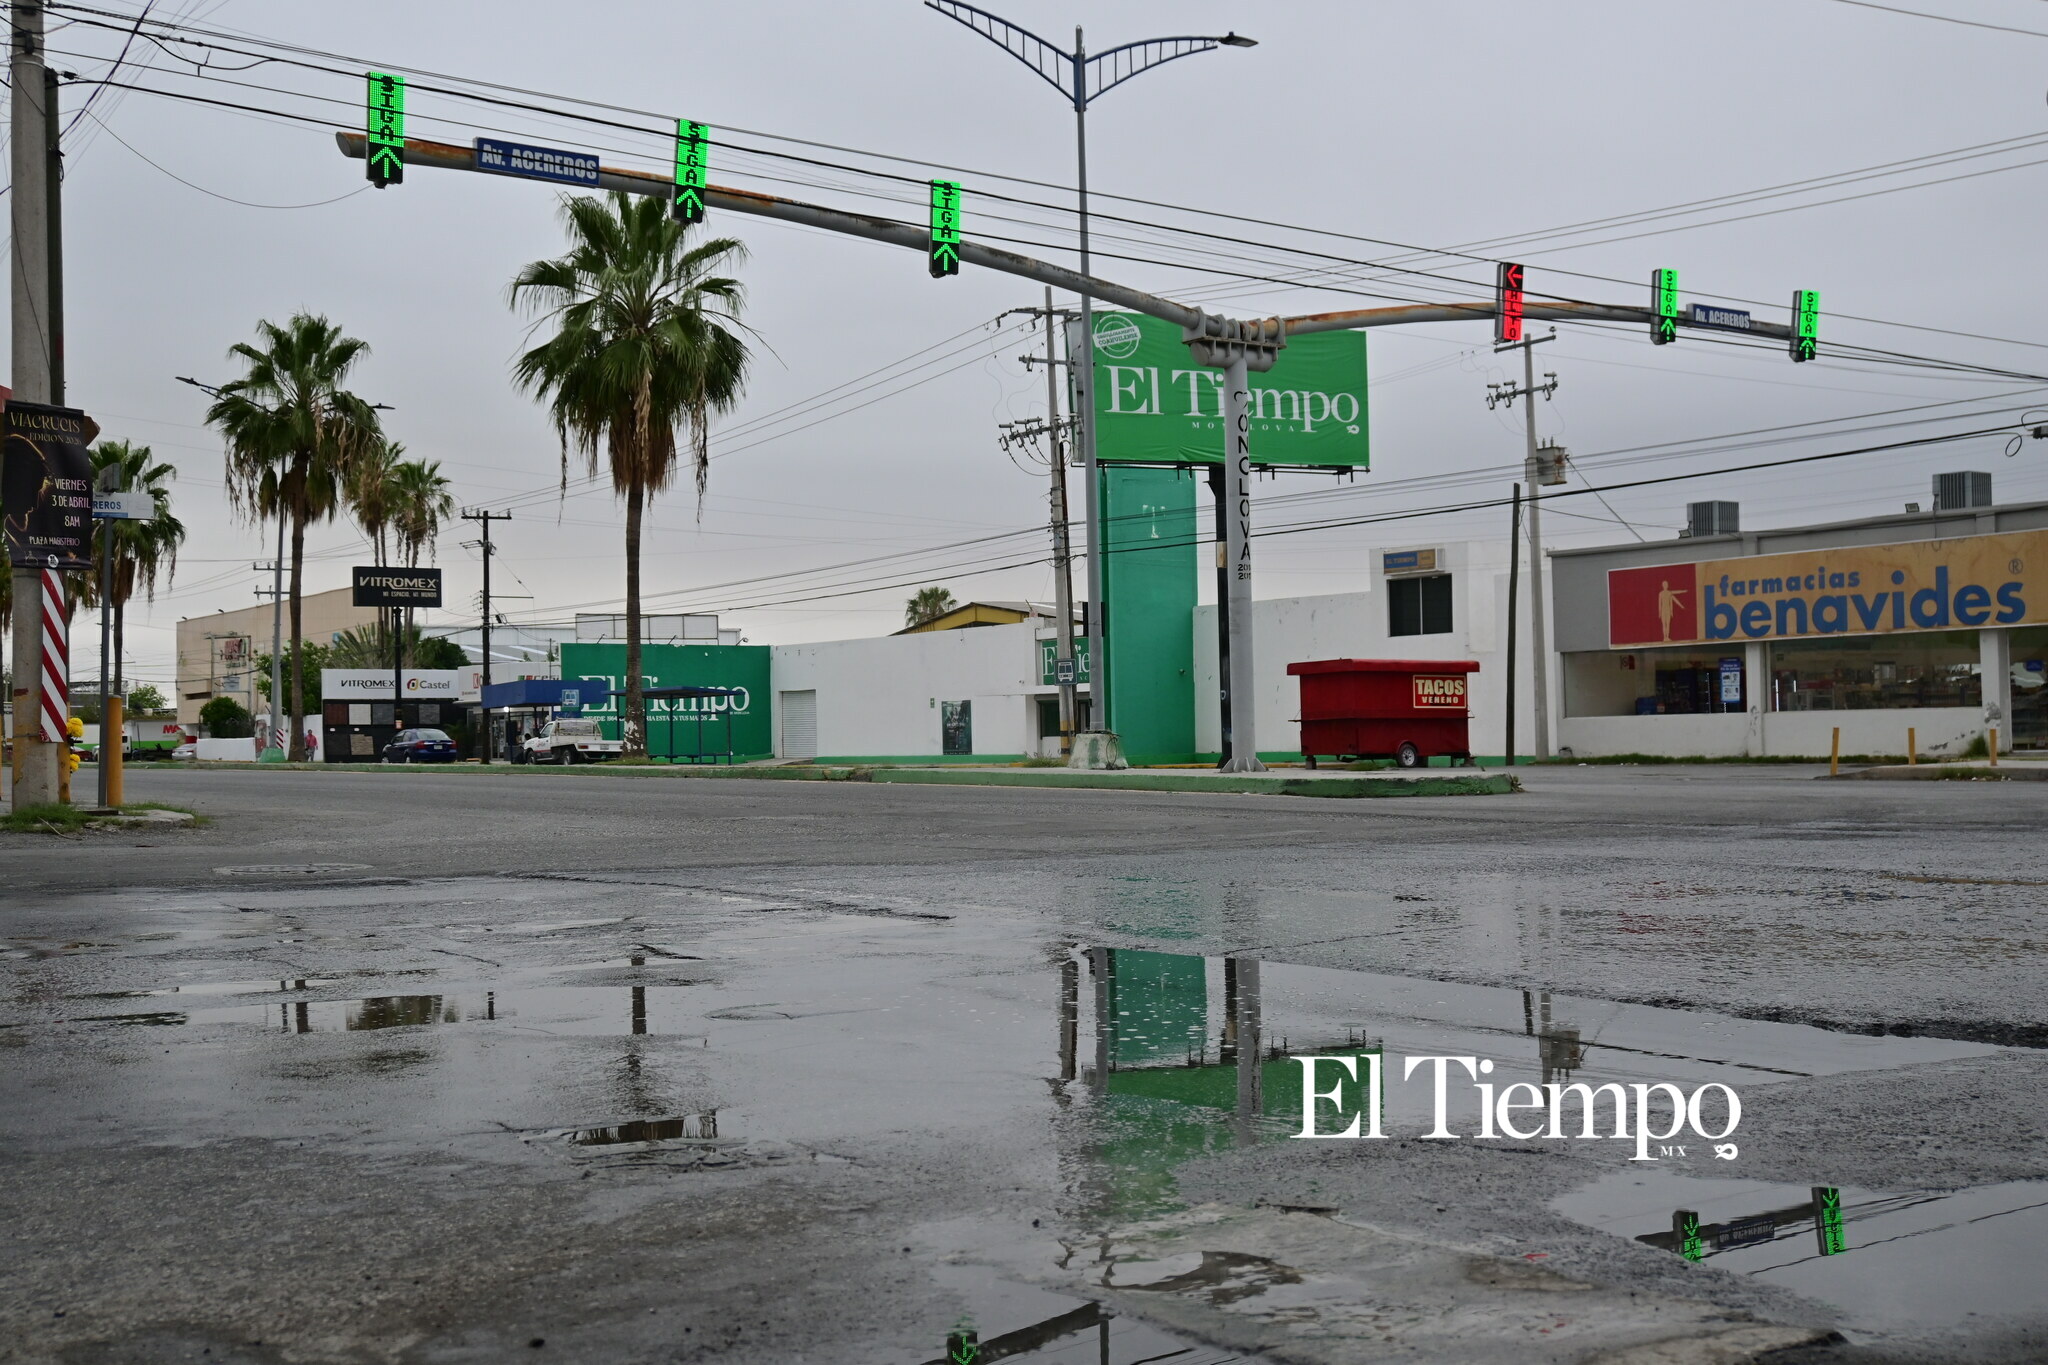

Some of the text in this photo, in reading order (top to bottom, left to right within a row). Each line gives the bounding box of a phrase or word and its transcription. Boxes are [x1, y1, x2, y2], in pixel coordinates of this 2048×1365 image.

[685, 120, 701, 185] SIGA
[481, 143, 598, 181] Av. ACEREROS
[1665, 270, 1674, 315] SIGA
[1708, 311, 1750, 329] ACEREROS
[1804, 291, 1814, 334] SIGA
[1102, 364, 1360, 433] El Timpo
[10, 411, 81, 434] VIACRUCIS
[1191, 421, 1296, 433] MOLOVA
[54, 478, 87, 491] VIERNES
[51, 494, 91, 508] 3 DE ABRIL
[64, 515, 80, 527] 8AM
[29, 535, 81, 547] PLAZA MAGISTERIO
[359, 576, 436, 591] VITROMEX
[1719, 566, 1861, 597] farmacias
[1704, 565, 2026, 640] benavides
[341, 679, 395, 689] VITROMEX
[419, 680, 450, 689] Castel
[1415, 679, 1465, 696] TACOS
[1421, 696, 1459, 704] VENENO
